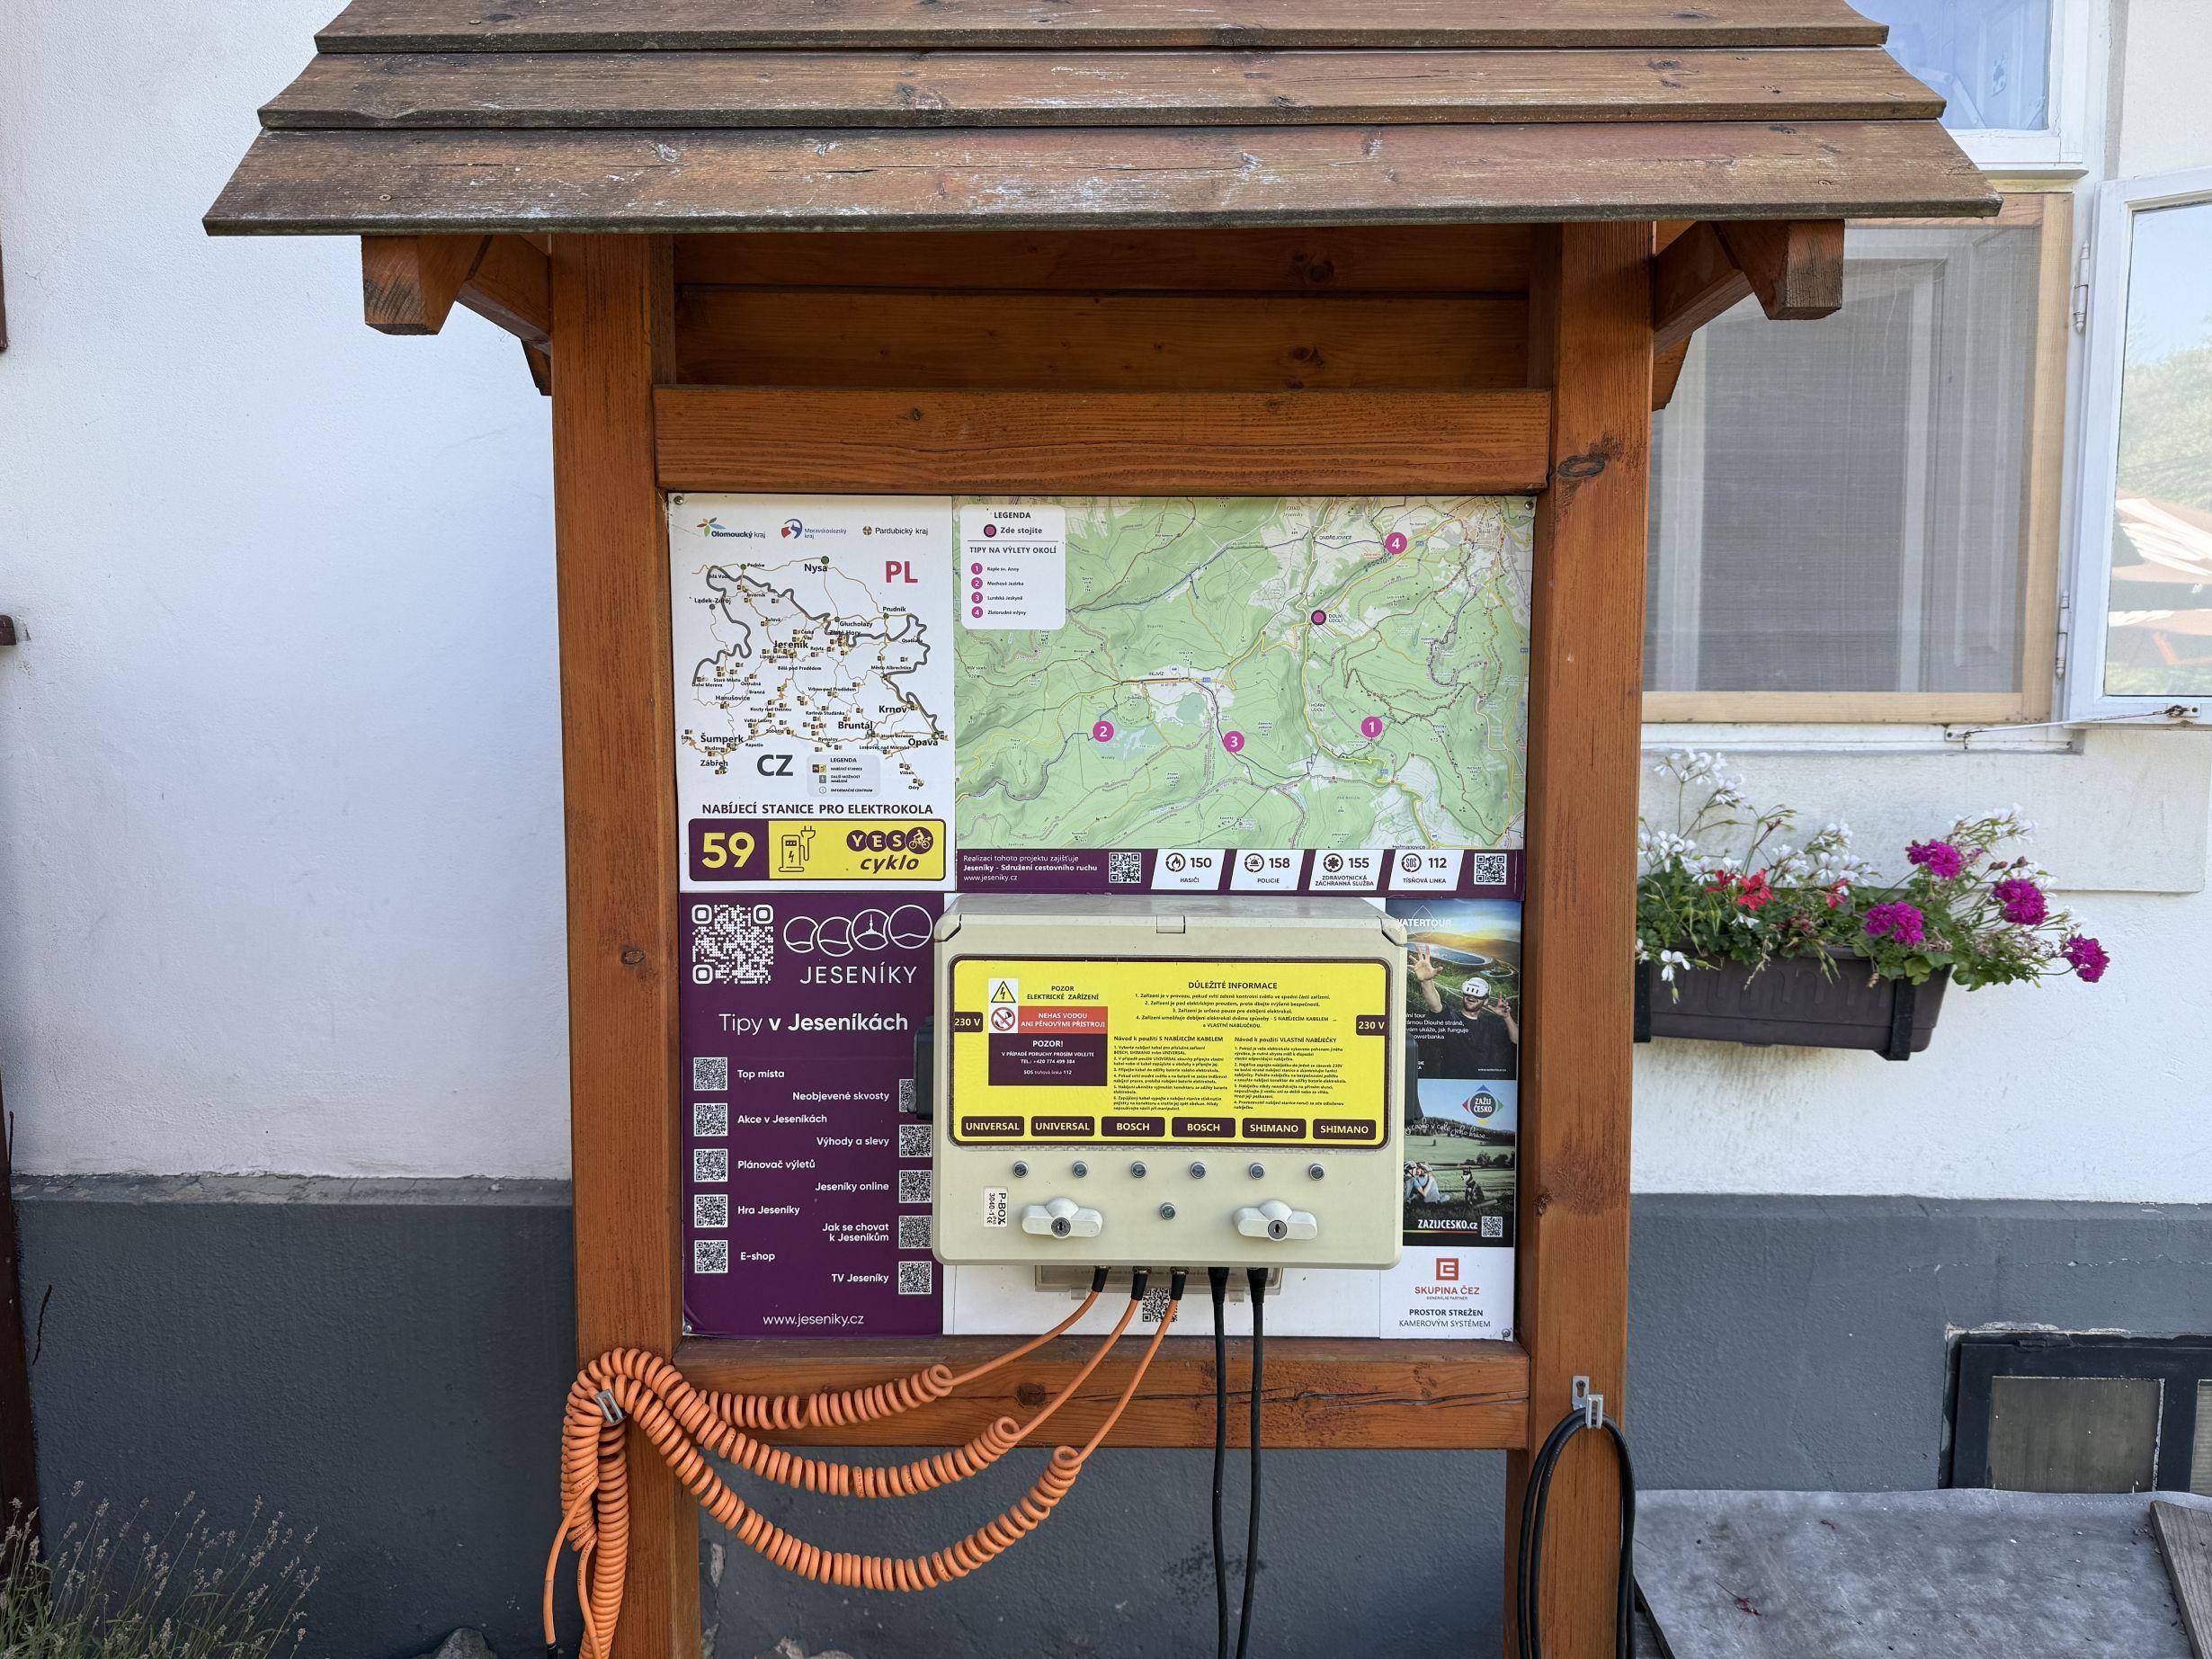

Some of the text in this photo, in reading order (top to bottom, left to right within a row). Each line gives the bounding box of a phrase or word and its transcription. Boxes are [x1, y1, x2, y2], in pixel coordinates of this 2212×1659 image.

[1018, 527, 1042, 535] stojíte
[1392, 539, 1400, 549] 4
[1003, 546, 1030, 554] VÝLETY
[1033, 546, 1057, 554] OKOLÍ
[805, 564, 828, 574] Nysa
[886, 561, 918, 584] PL
[879, 705, 906, 714] Krnov
[838, 721, 872, 730] Bruntál
[1369, 722, 1375, 733] 1
[1099, 727, 1108, 737] 2
[700, 733, 744, 744] Šumperk
[909, 738, 938, 746] Opava
[1231, 736, 1238, 747] 3
[757, 754, 793, 776] CZ
[702, 802, 932, 815] NABÍJECÍ STANICE PRO ELEKTROKOLA
[702, 832, 755, 869] 59
[1050, 855, 1079, 863] zajišťuje
[1191, 858, 1212, 869] 150
[1269, 858, 1290, 869] 158
[1349, 858, 1369, 869] 155
[1406, 858, 1417, 868] SOS
[1429, 858, 1447, 869] 112
[861, 855, 919, 874] cyklo
[964, 864, 994, 872] Jeseníky
[800, 962, 917, 984] JESENÍKY
[1189, 980, 1226, 989] DŮLEŽITÉ
[718, 1013, 908, 1035] Tipy v Jeseníkách
[1359, 1021, 1376, 1030] 230
[737, 1070, 784, 1080] Top místa
[793, 1092, 889, 1102] Neobjevené skvosty
[1475, 1097, 1492, 1105] ZAŽIJ
[1474, 1104, 1493, 1113] ČESKO
[738, 1115, 762, 1123] Akce
[772, 1114, 827, 1123] Jeseníkách
[1117, 1123, 1150, 1131] BOSCH
[1188, 1124, 1220, 1132] BOSCH
[1250, 1124, 1298, 1133] SHIMANO
[1321, 1126, 1369, 1134] SHIMANO
[816, 1137, 852, 1147] Výhody
[865, 1137, 889, 1146] slevy
[738, 1159, 816, 1170] Plánovač výletů
[816, 1182, 889, 1192] Jeseníky online
[738, 1206, 800, 1216] Hra Jeseníky
[998, 1193, 1006, 1224] P-BOX
[823, 1223, 840, 1232] Jak
[856, 1223, 889, 1232] chovat
[1418, 1219, 1477, 1229] ZAZIJCESKO.cz
[830, 1232, 889, 1243] k Jeseníkům
[741, 1253, 775, 1262] E-shop
[832, 1274, 889, 1284] TV Jeseníky
[1415, 1285, 1480, 1295] SKUPINA ČEZ
[763, 1314, 864, 1326] www.jeseniky.cz
[1399, 1319, 1491, 1327] KAMEROVÝM SYSTÉMEM
